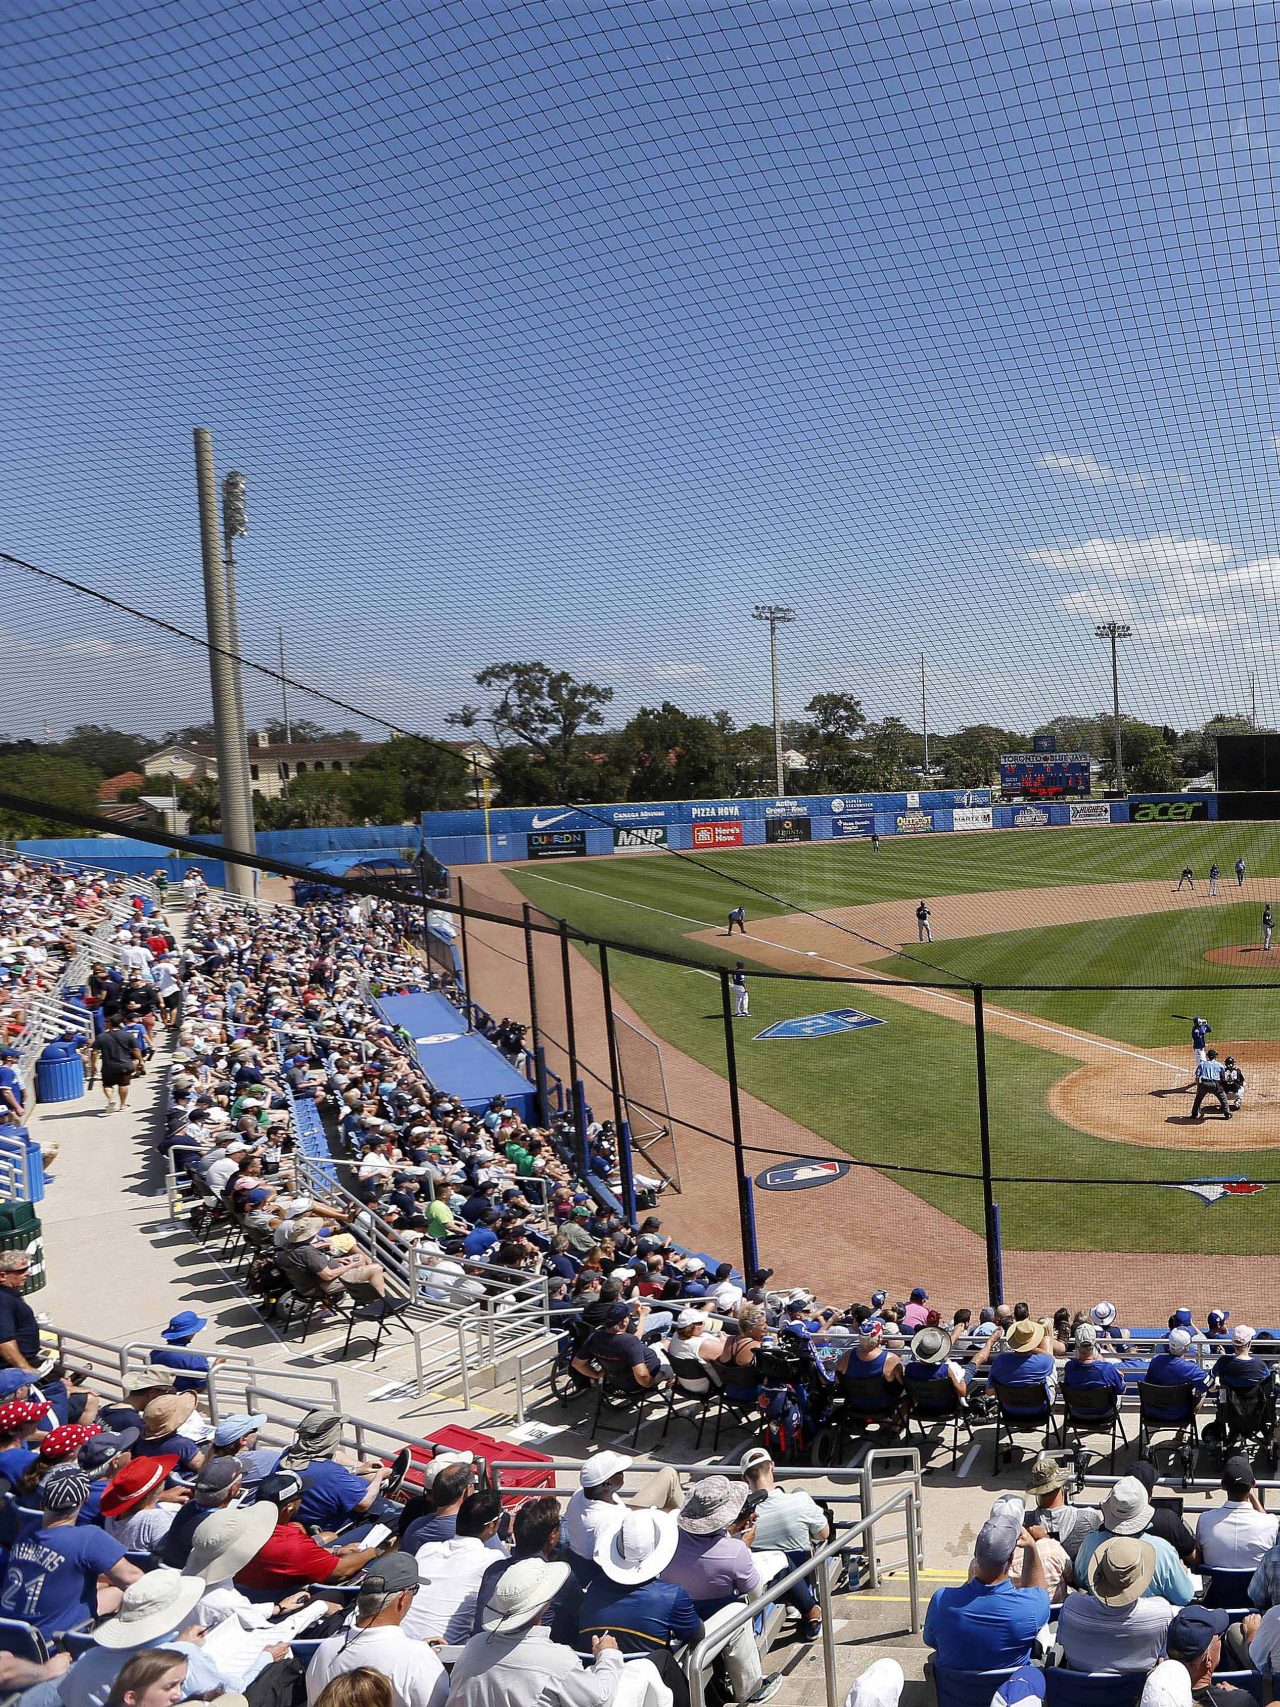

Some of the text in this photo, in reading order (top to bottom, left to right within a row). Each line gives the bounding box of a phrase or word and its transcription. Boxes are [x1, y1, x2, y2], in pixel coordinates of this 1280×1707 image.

[1002, 755, 1041, 763] TORONTO
[691, 805, 740, 818] PIZZA NOVA
[1134, 801, 1202, 821] acer
[896, 815, 933, 826] OUTPOST
[617, 828, 664, 846] MNP
[715, 826, 740, 835] Here's
[0, 1566, 46, 1616] 21
